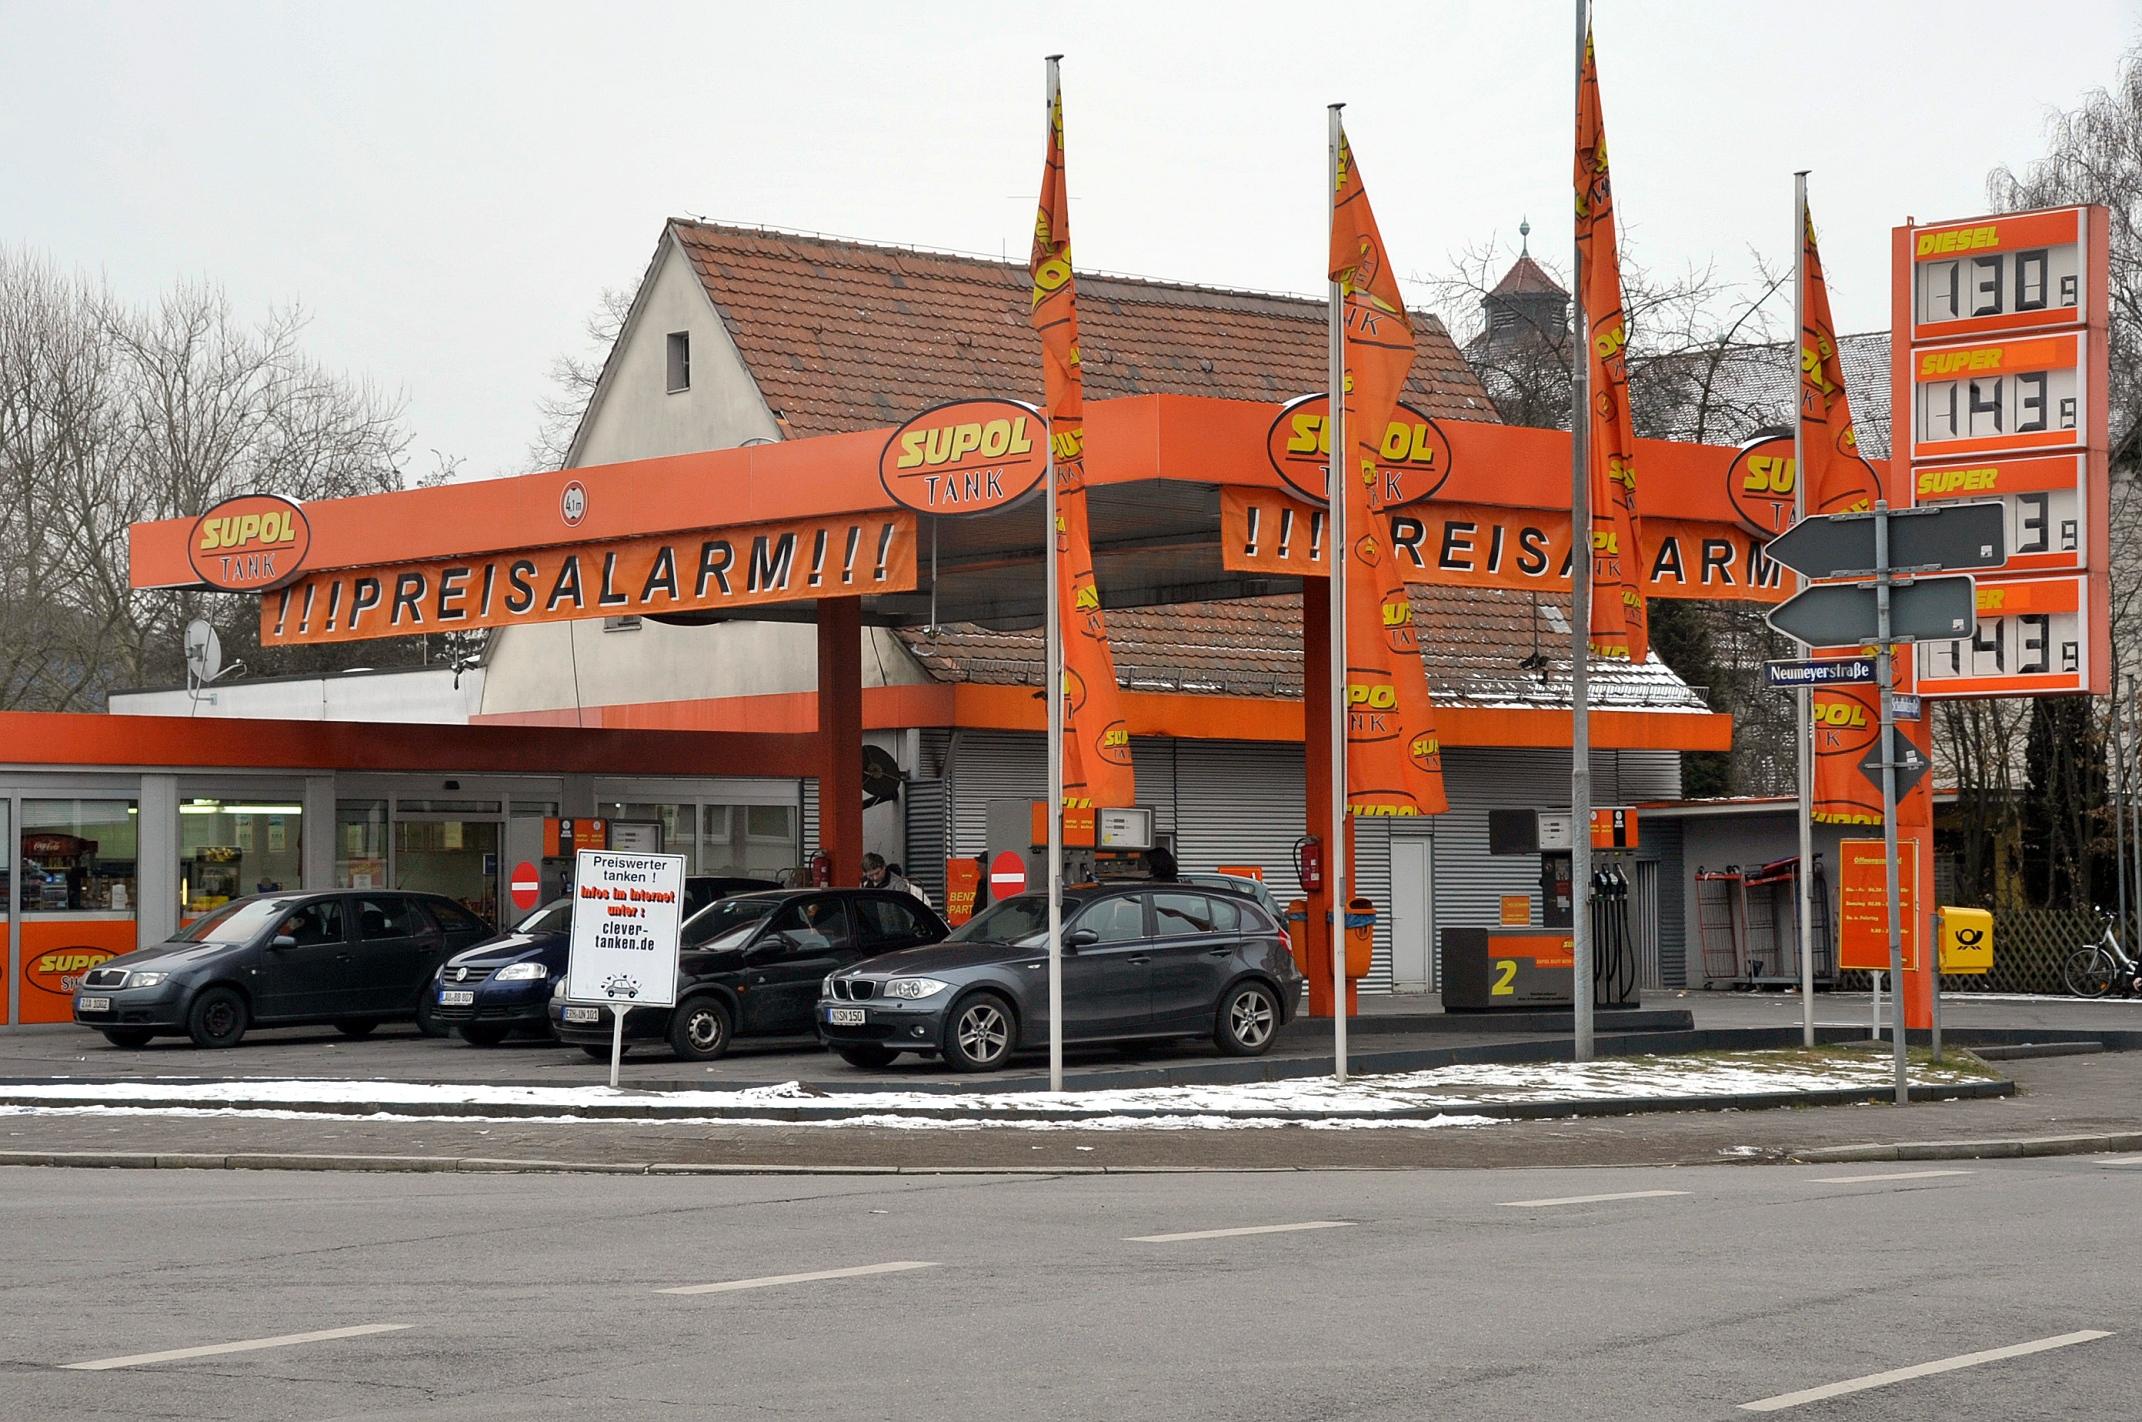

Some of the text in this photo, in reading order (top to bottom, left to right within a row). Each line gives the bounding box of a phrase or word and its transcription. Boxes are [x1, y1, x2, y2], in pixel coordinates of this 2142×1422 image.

[1917, 226, 2000, 256] DIESEL
[1921, 348, 2003, 375] SUPER
[897, 416, 1032, 469] SUPOL
[924, 468, 1004, 506] TANK
[1918, 468, 1998, 494] SUPER
[200, 510, 295, 550] SUPOL
[220, 552, 276, 582] TANK
[1771, 661, 1870, 682] Neumeyerstraße
[593, 856, 668, 871] Preiswerter
[603, 871, 646, 883] tanken
[580, 885, 676, 904] Infos im Internet
[607, 904, 638, 918] unter
[602, 921, 649, 935] clever-
[595, 935, 655, 951] tanken.de
[39, 954, 114, 973] SUPO
[1491, 960, 1518, 996] 2
